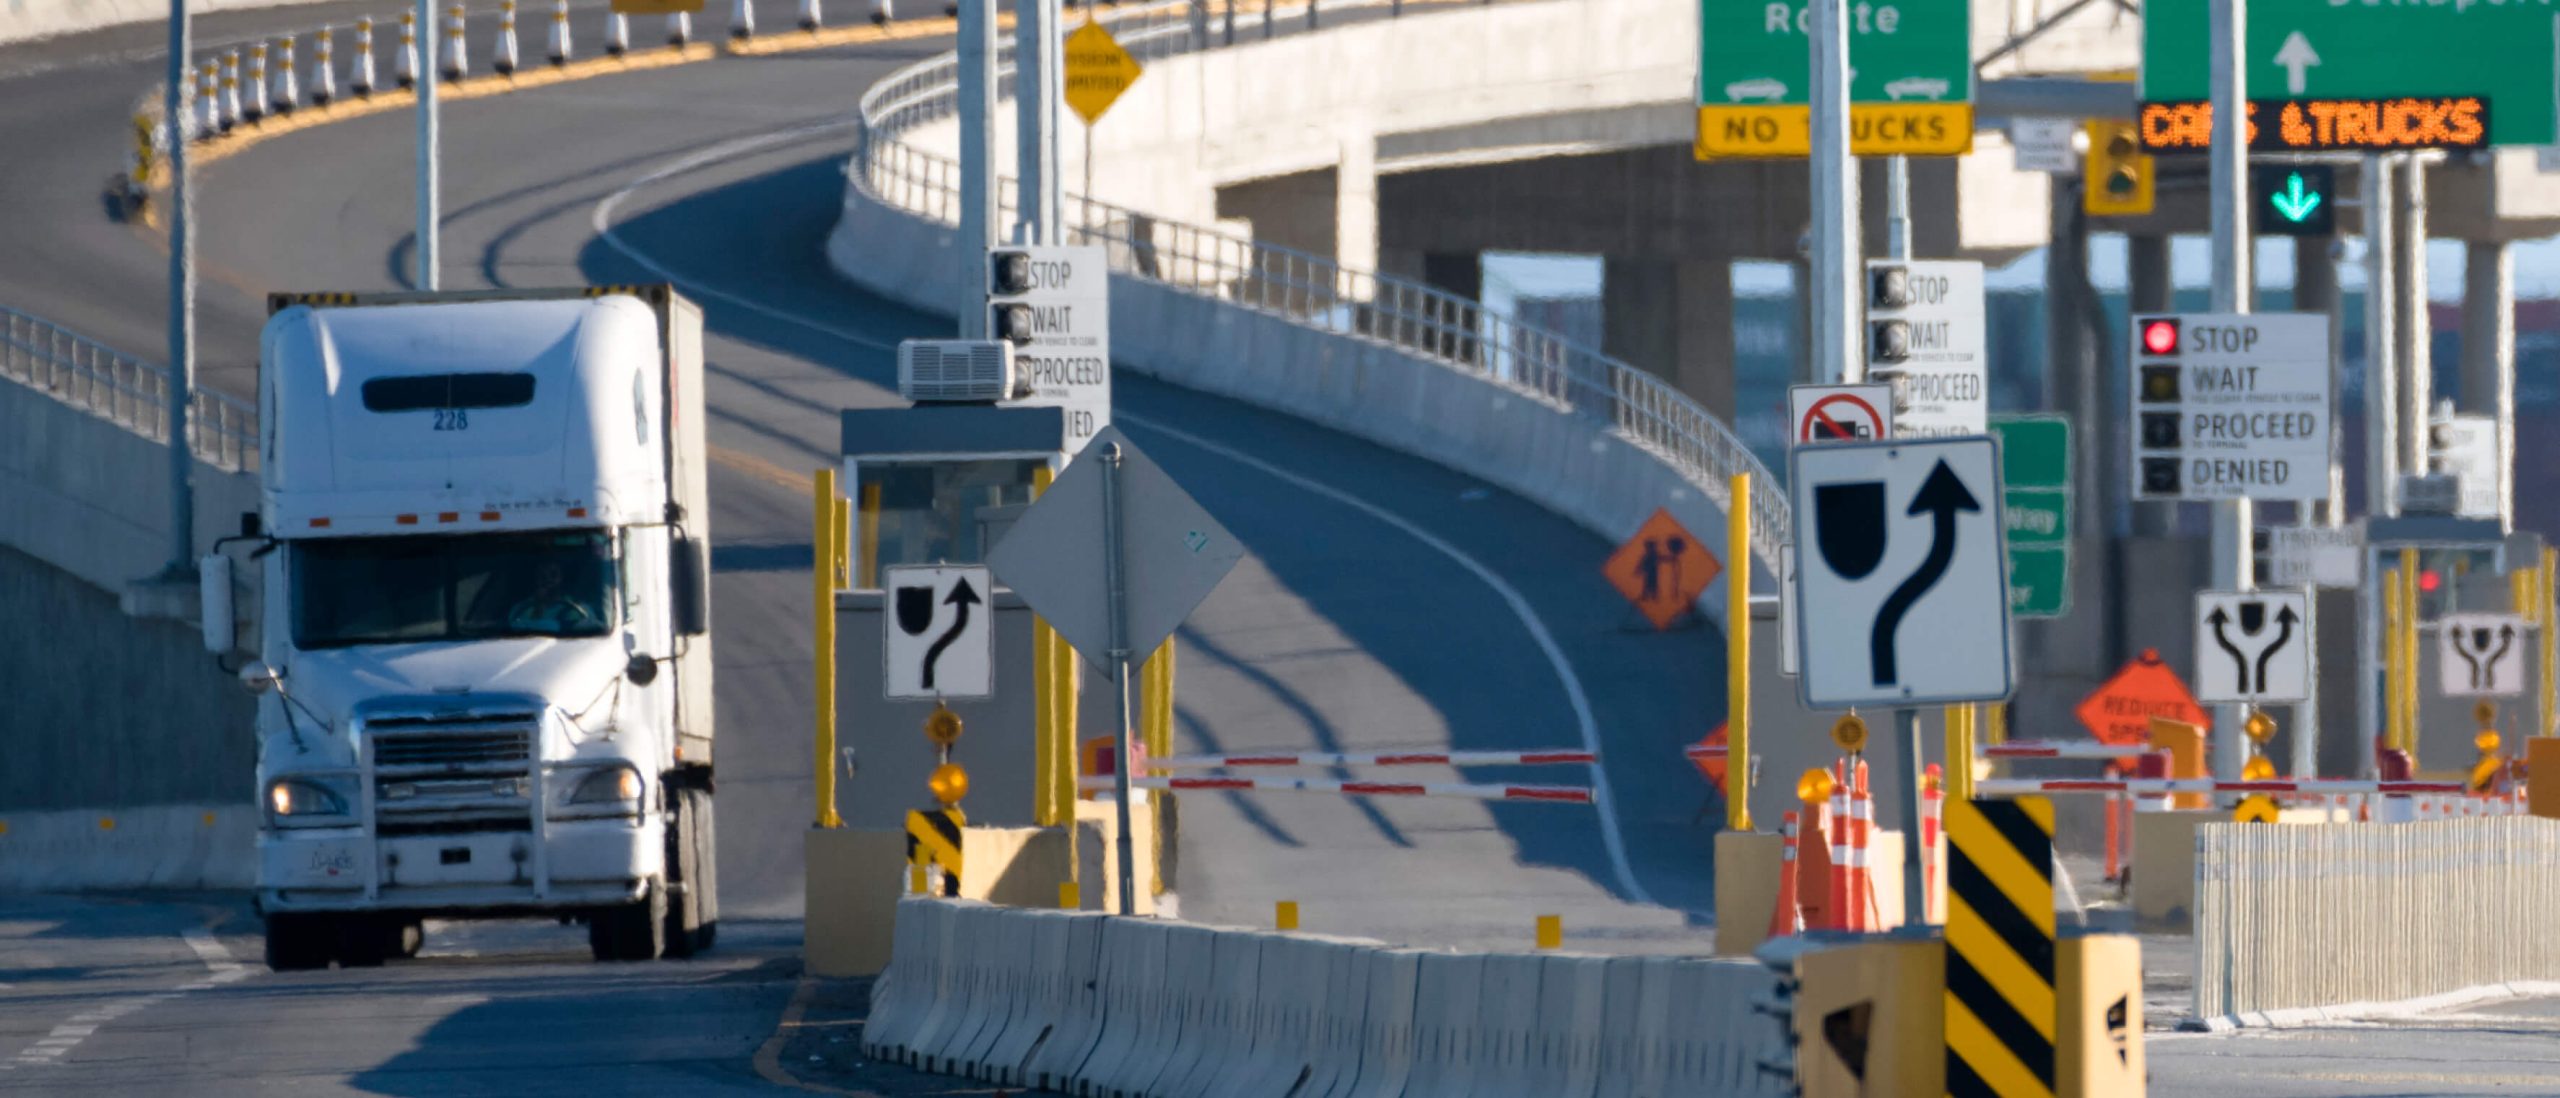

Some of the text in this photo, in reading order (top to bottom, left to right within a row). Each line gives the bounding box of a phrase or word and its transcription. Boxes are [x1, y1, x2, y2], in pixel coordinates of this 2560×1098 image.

[1765, 2, 1899, 34] Rote
[1724, 114, 1945, 142] NO UCKS
[1031, 261, 1072, 289] STOP
[1908, 277, 1948, 304] STOP
[1031, 305, 1072, 334] WAIT
[1908, 322, 1950, 348] WAIT
[2191, 327, 2258, 353] STOP
[1032, 358, 1104, 385] PROCEED
[2192, 366, 2259, 391] WAIT
[1909, 373, 1979, 401] PROCEED
[433, 408, 468, 431] 228
[1066, 412, 1094, 438] IED
[2192, 413, 2316, 439] PROCEED
[2192, 458, 2289, 485] DENIED
